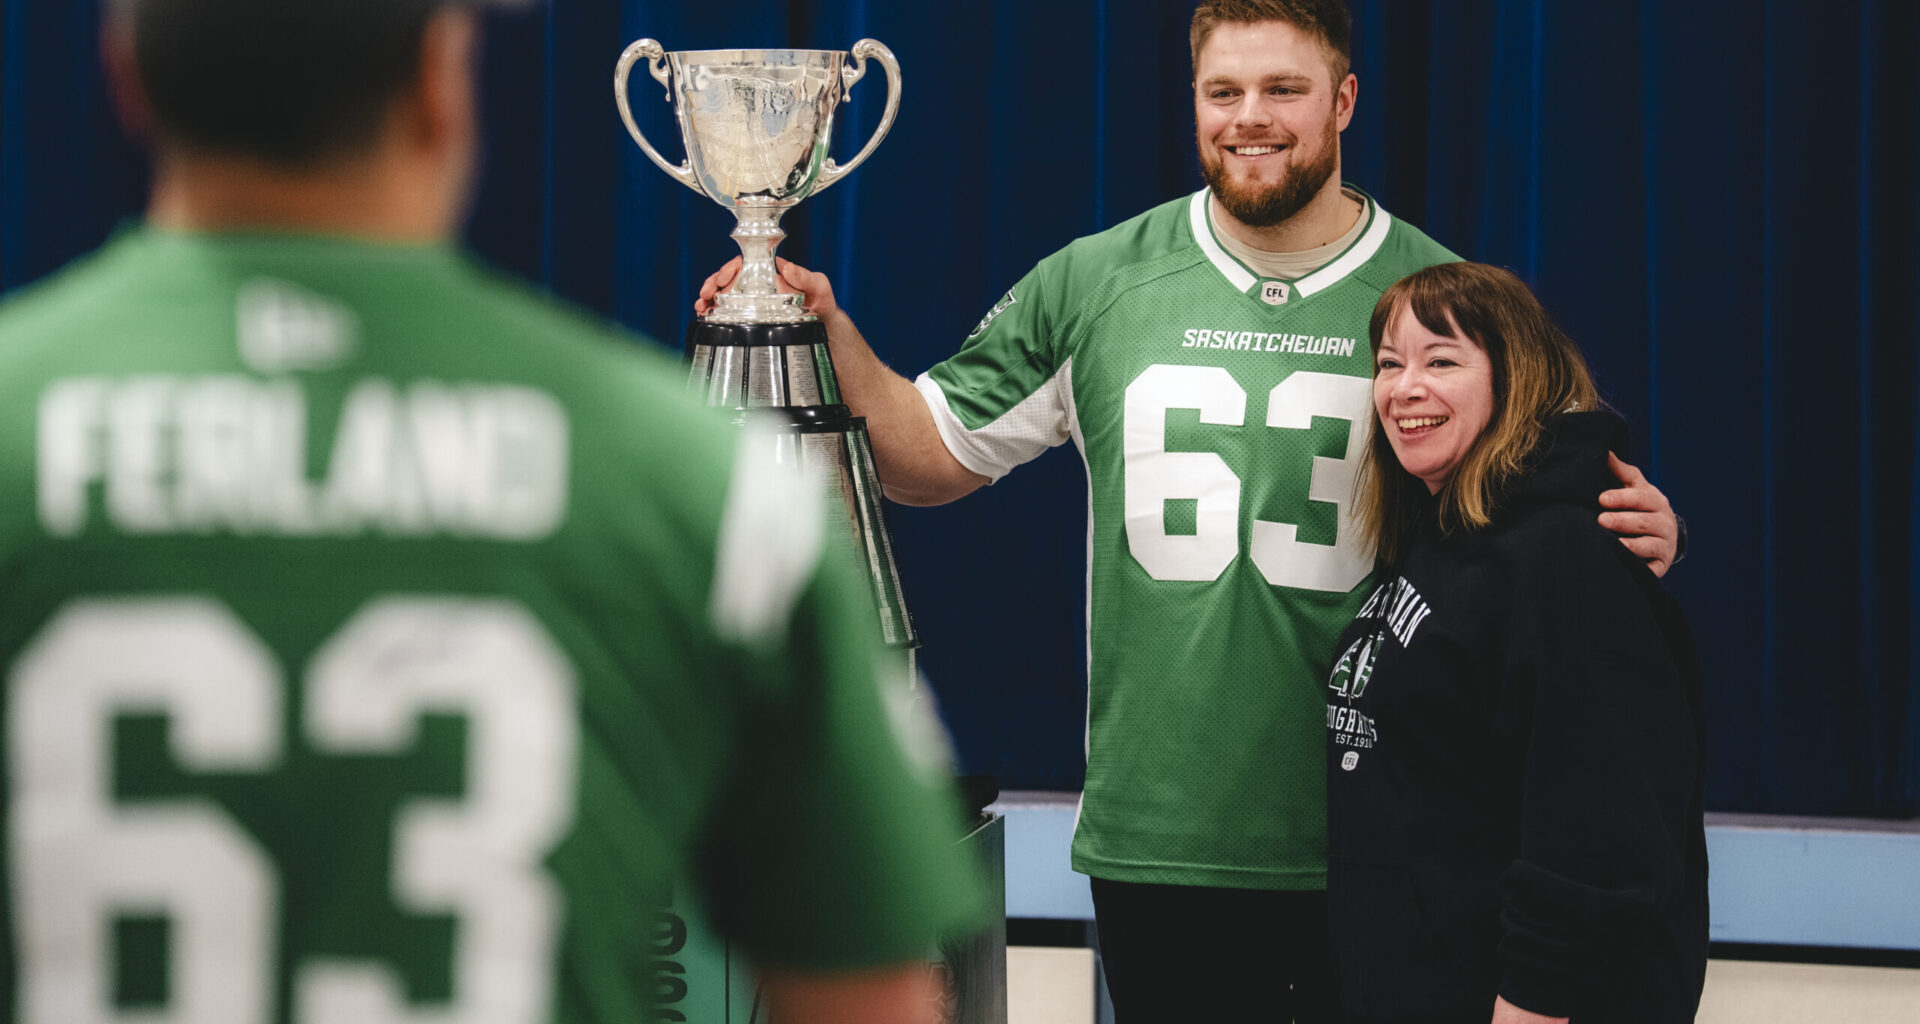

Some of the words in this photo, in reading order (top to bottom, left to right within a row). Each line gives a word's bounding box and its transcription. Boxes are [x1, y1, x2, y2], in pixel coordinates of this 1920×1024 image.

[1182, 328, 1356, 358] SASKATCHEWAN
[1266, 288, 1284, 298] CFL
[36, 374, 571, 541] FERLAND
[1123, 363, 1376, 592] 63
[9, 597, 577, 1024] 63
